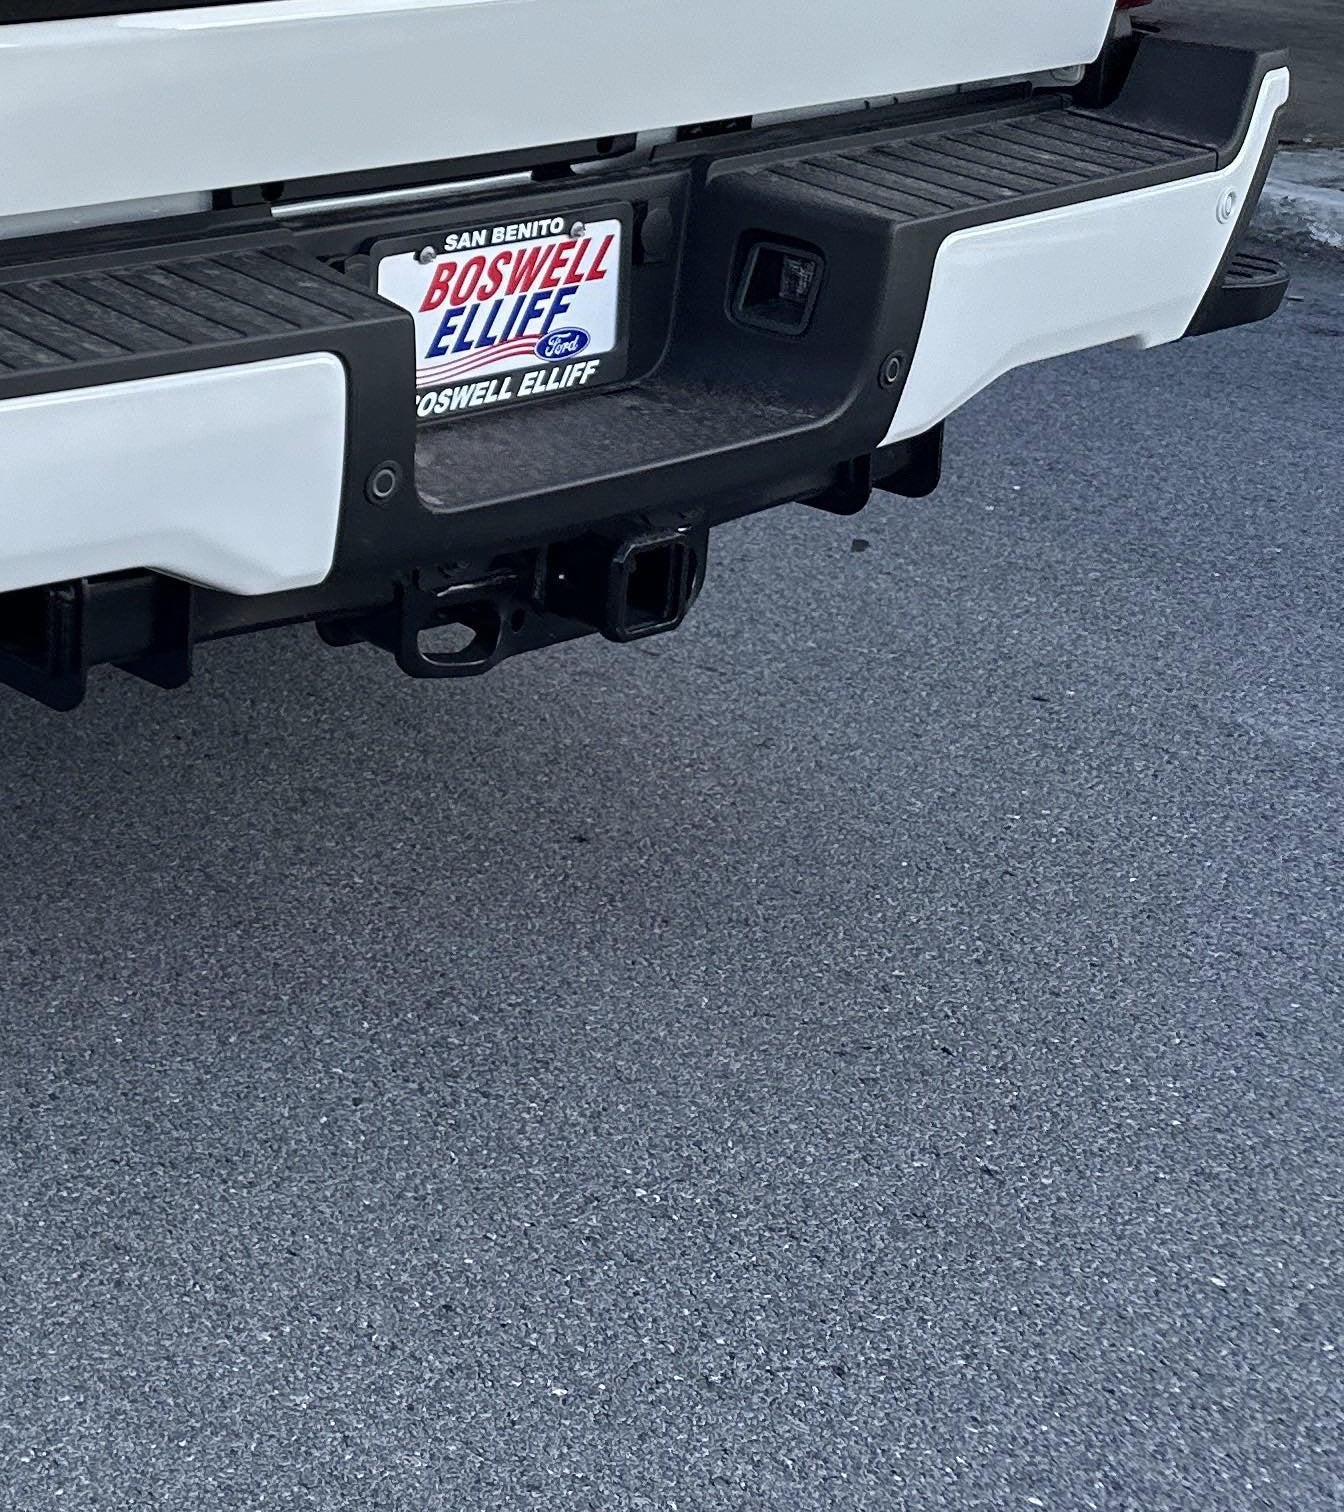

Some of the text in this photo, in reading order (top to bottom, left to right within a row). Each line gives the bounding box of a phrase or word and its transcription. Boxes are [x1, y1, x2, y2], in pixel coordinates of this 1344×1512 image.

[444, 217, 564, 252] SAN BENITO
[418, 234, 616, 313] BOSWELL
[424, 285, 580, 360] ELLIFF
[544, 331, 580, 357] Ford
[415, 359, 600, 417] OSWELL ELLIFF
